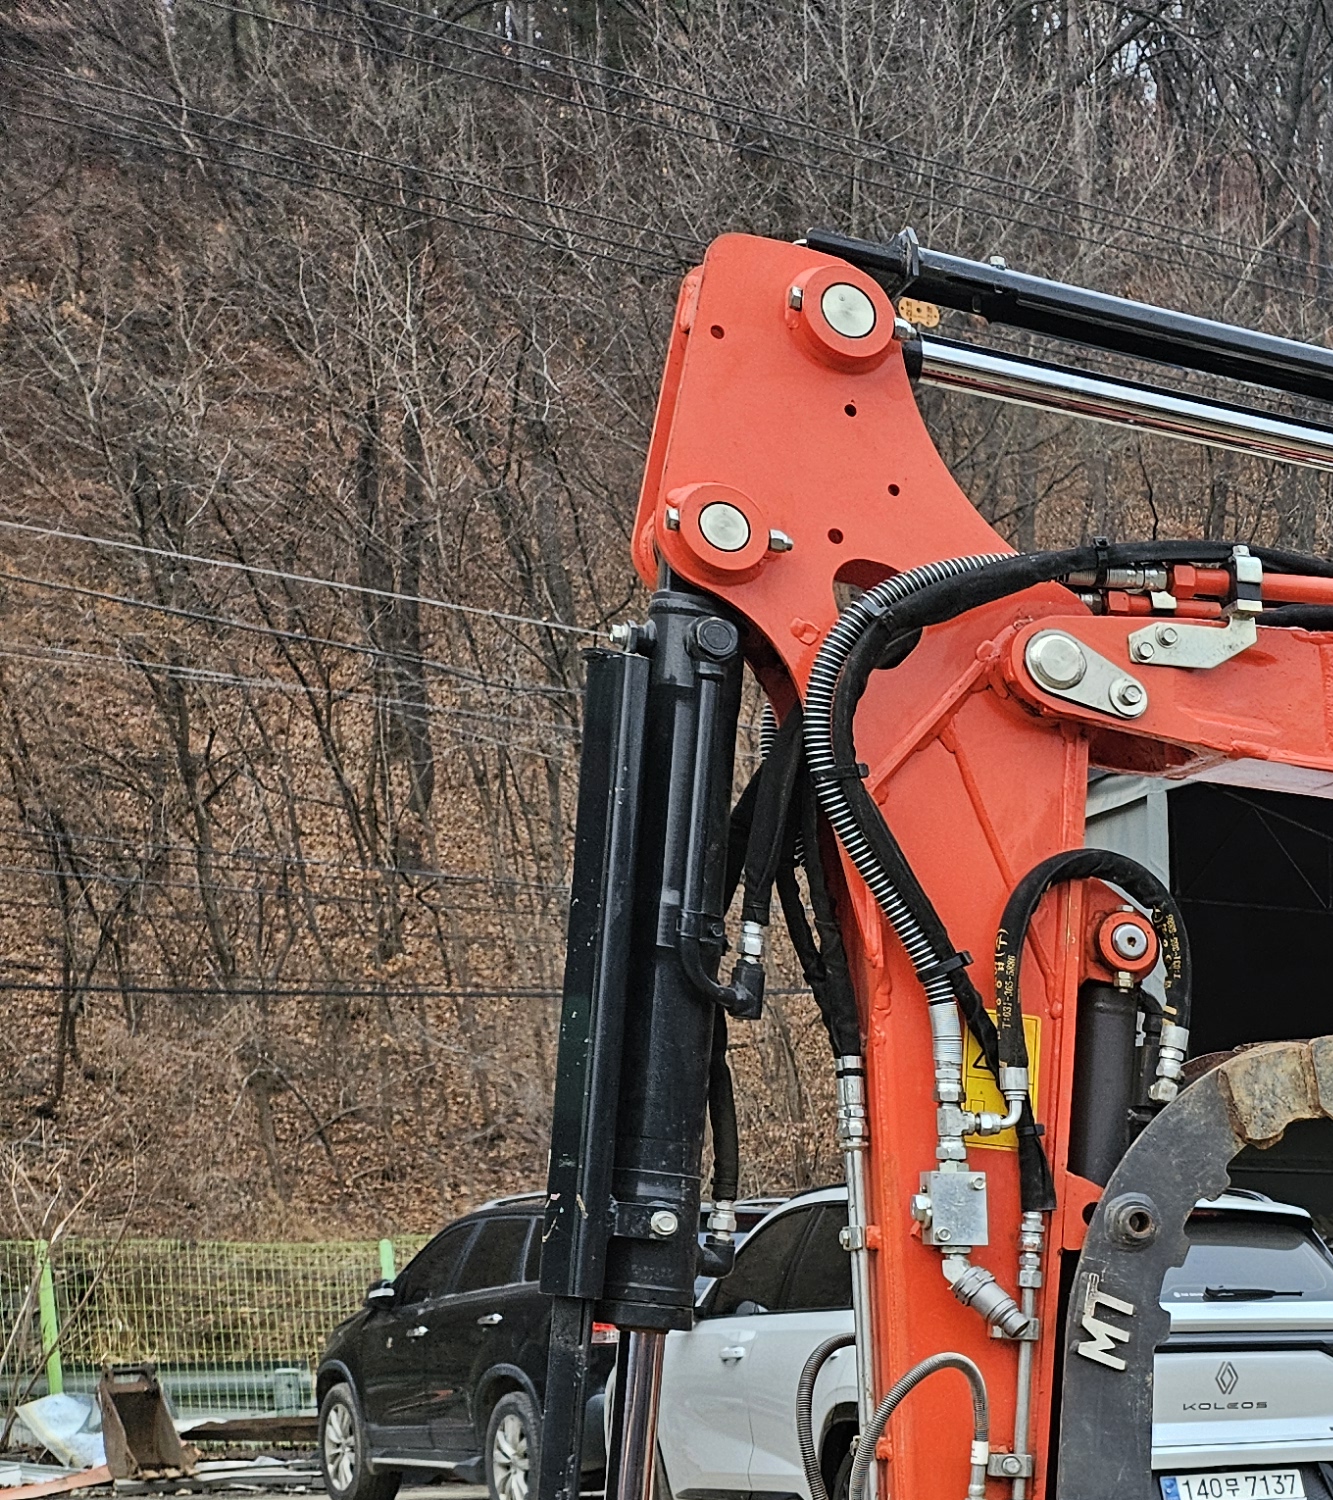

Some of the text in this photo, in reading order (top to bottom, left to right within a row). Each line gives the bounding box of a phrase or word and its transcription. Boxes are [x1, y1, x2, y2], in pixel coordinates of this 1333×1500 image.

[1078, 1273, 1135, 1371] MT
[1183, 1401, 1268, 1411] KOLEOS
[1182, 1473, 1296, 1500] 140무 7137
